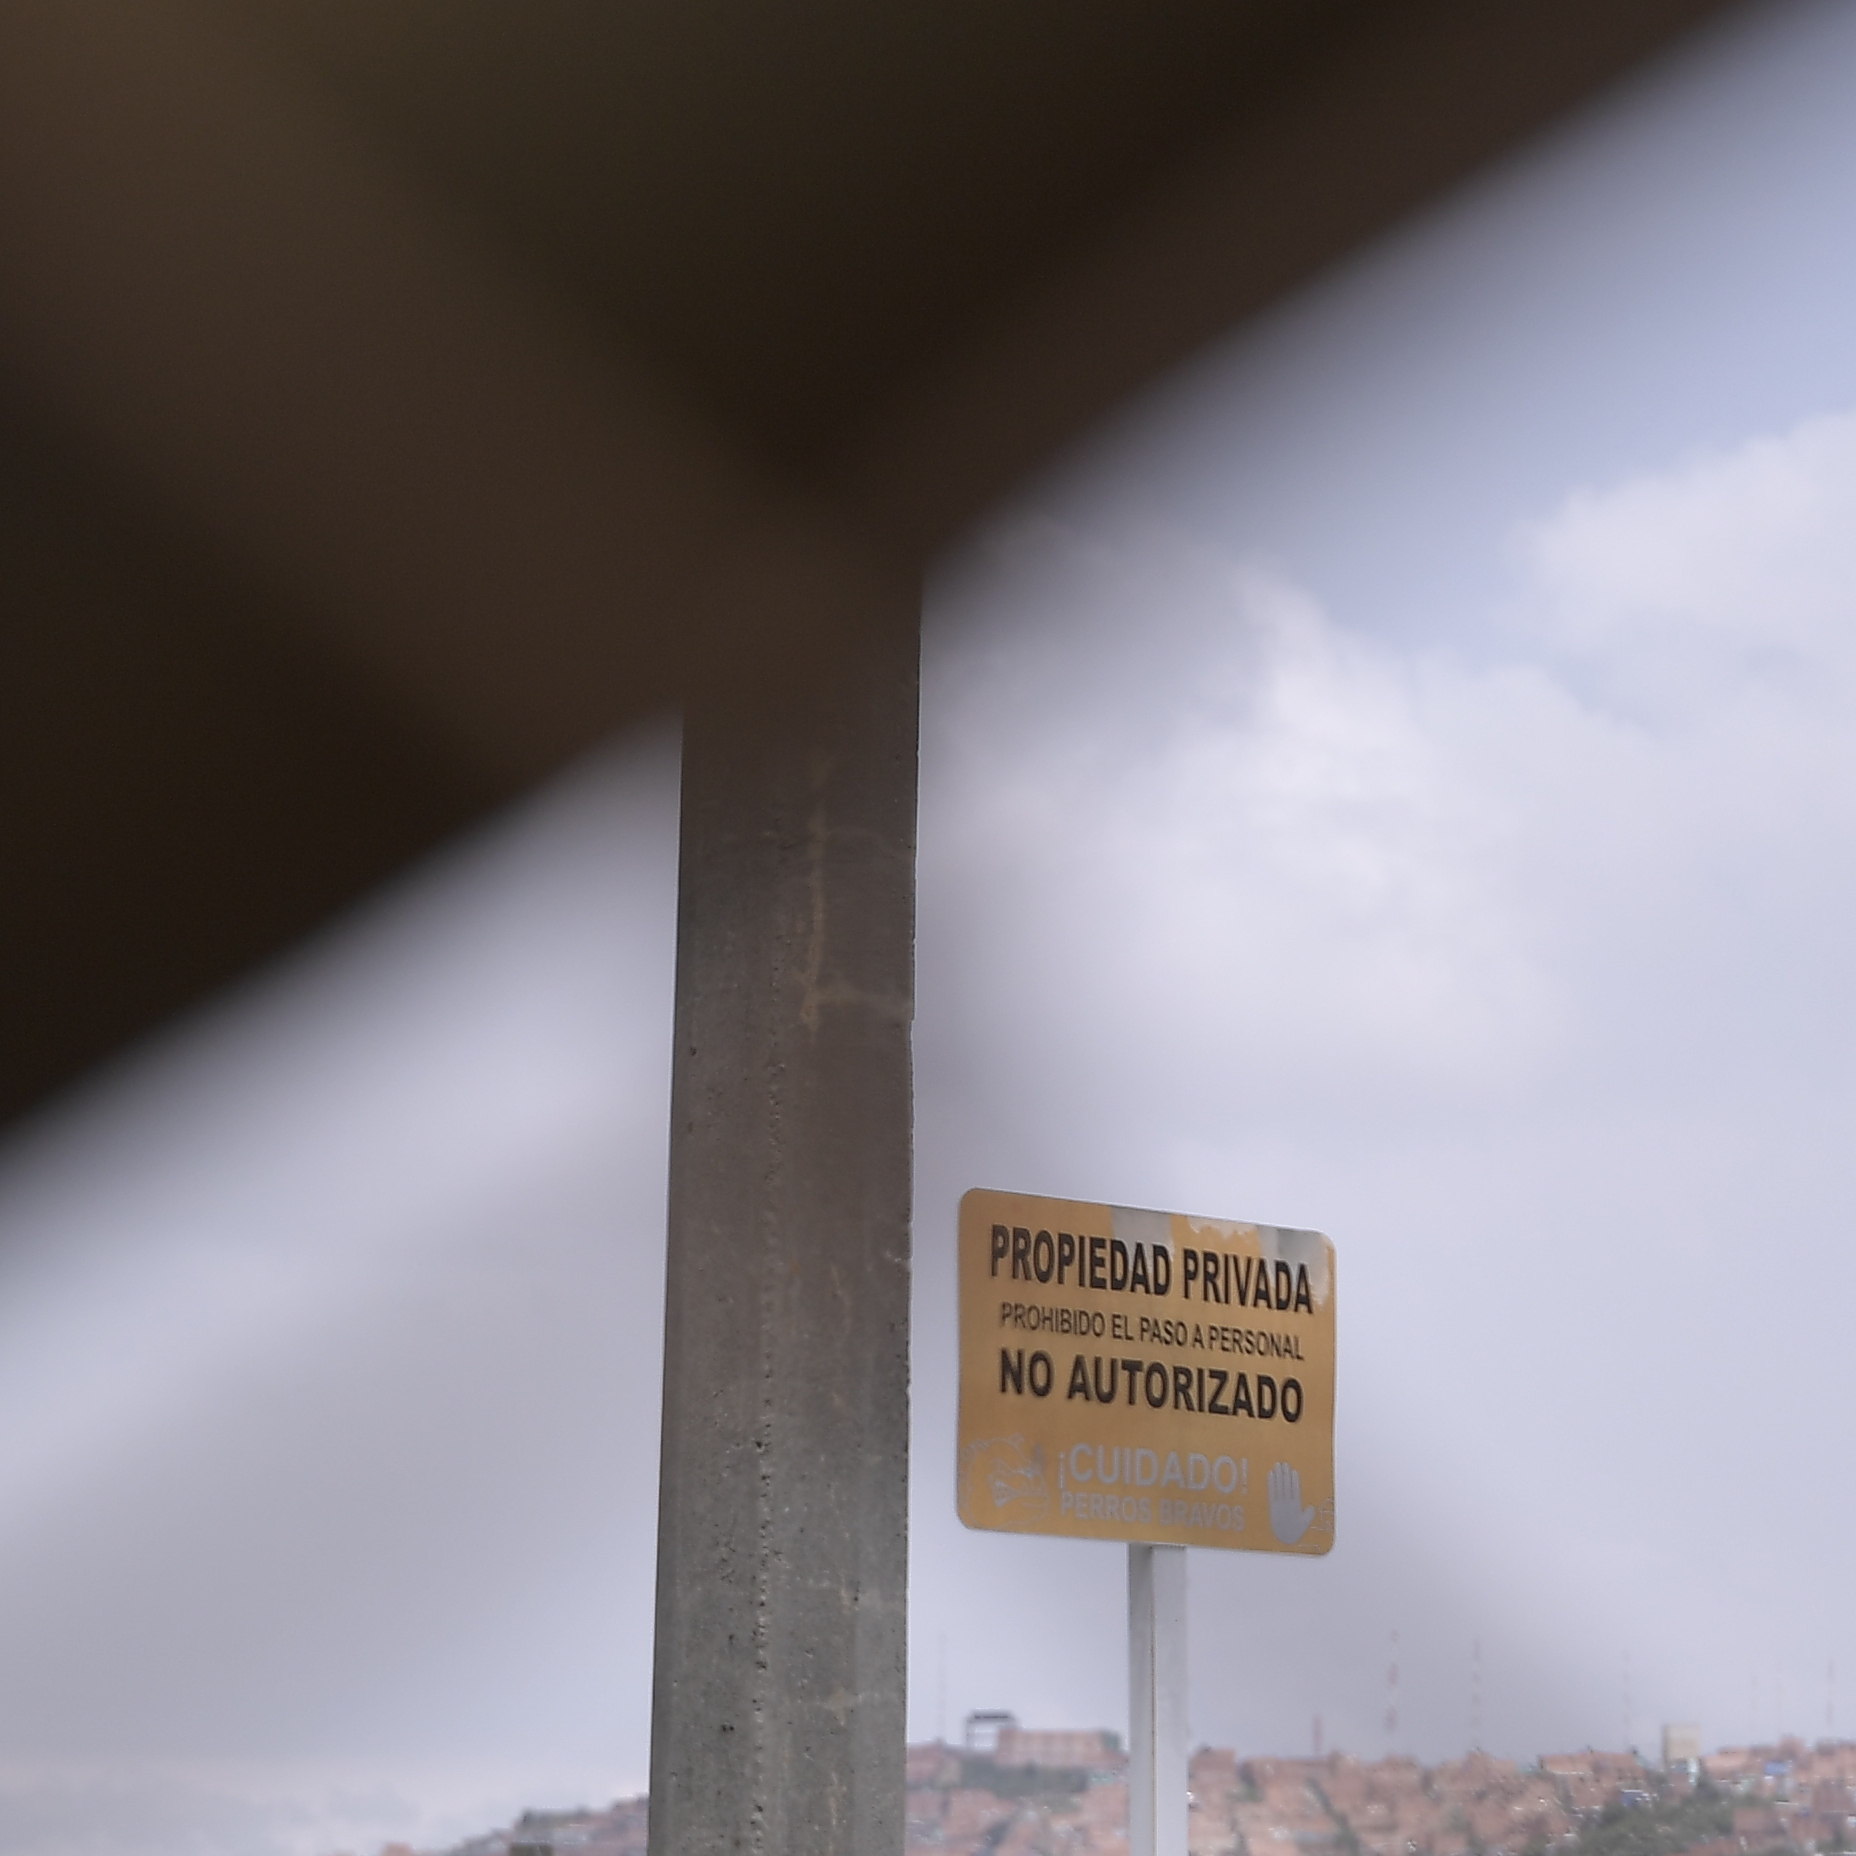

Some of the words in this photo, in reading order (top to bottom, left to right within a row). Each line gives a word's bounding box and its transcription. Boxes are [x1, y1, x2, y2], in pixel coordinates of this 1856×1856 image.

[990, 1224, 1171, 1297] PROPIEDAD
[1183, 1247, 1314, 1314] PRIVADA
[1001, 1301, 1106, 1338] PROHIBIDO
[1112, 1313, 1133, 1341] EL
[1140, 1316, 1188, 1346] PASO
[1193, 1324, 1204, 1348] A
[1209, 1324, 1304, 1360] PERSONAL
[1000, 1347, 1052, 1397] NO
[1067, 1354, 1304, 1423] AUTORIZADO
[1061, 1491, 1152, 1525] PERROS
[1159, 1498, 1245, 1532] BRAVOS
